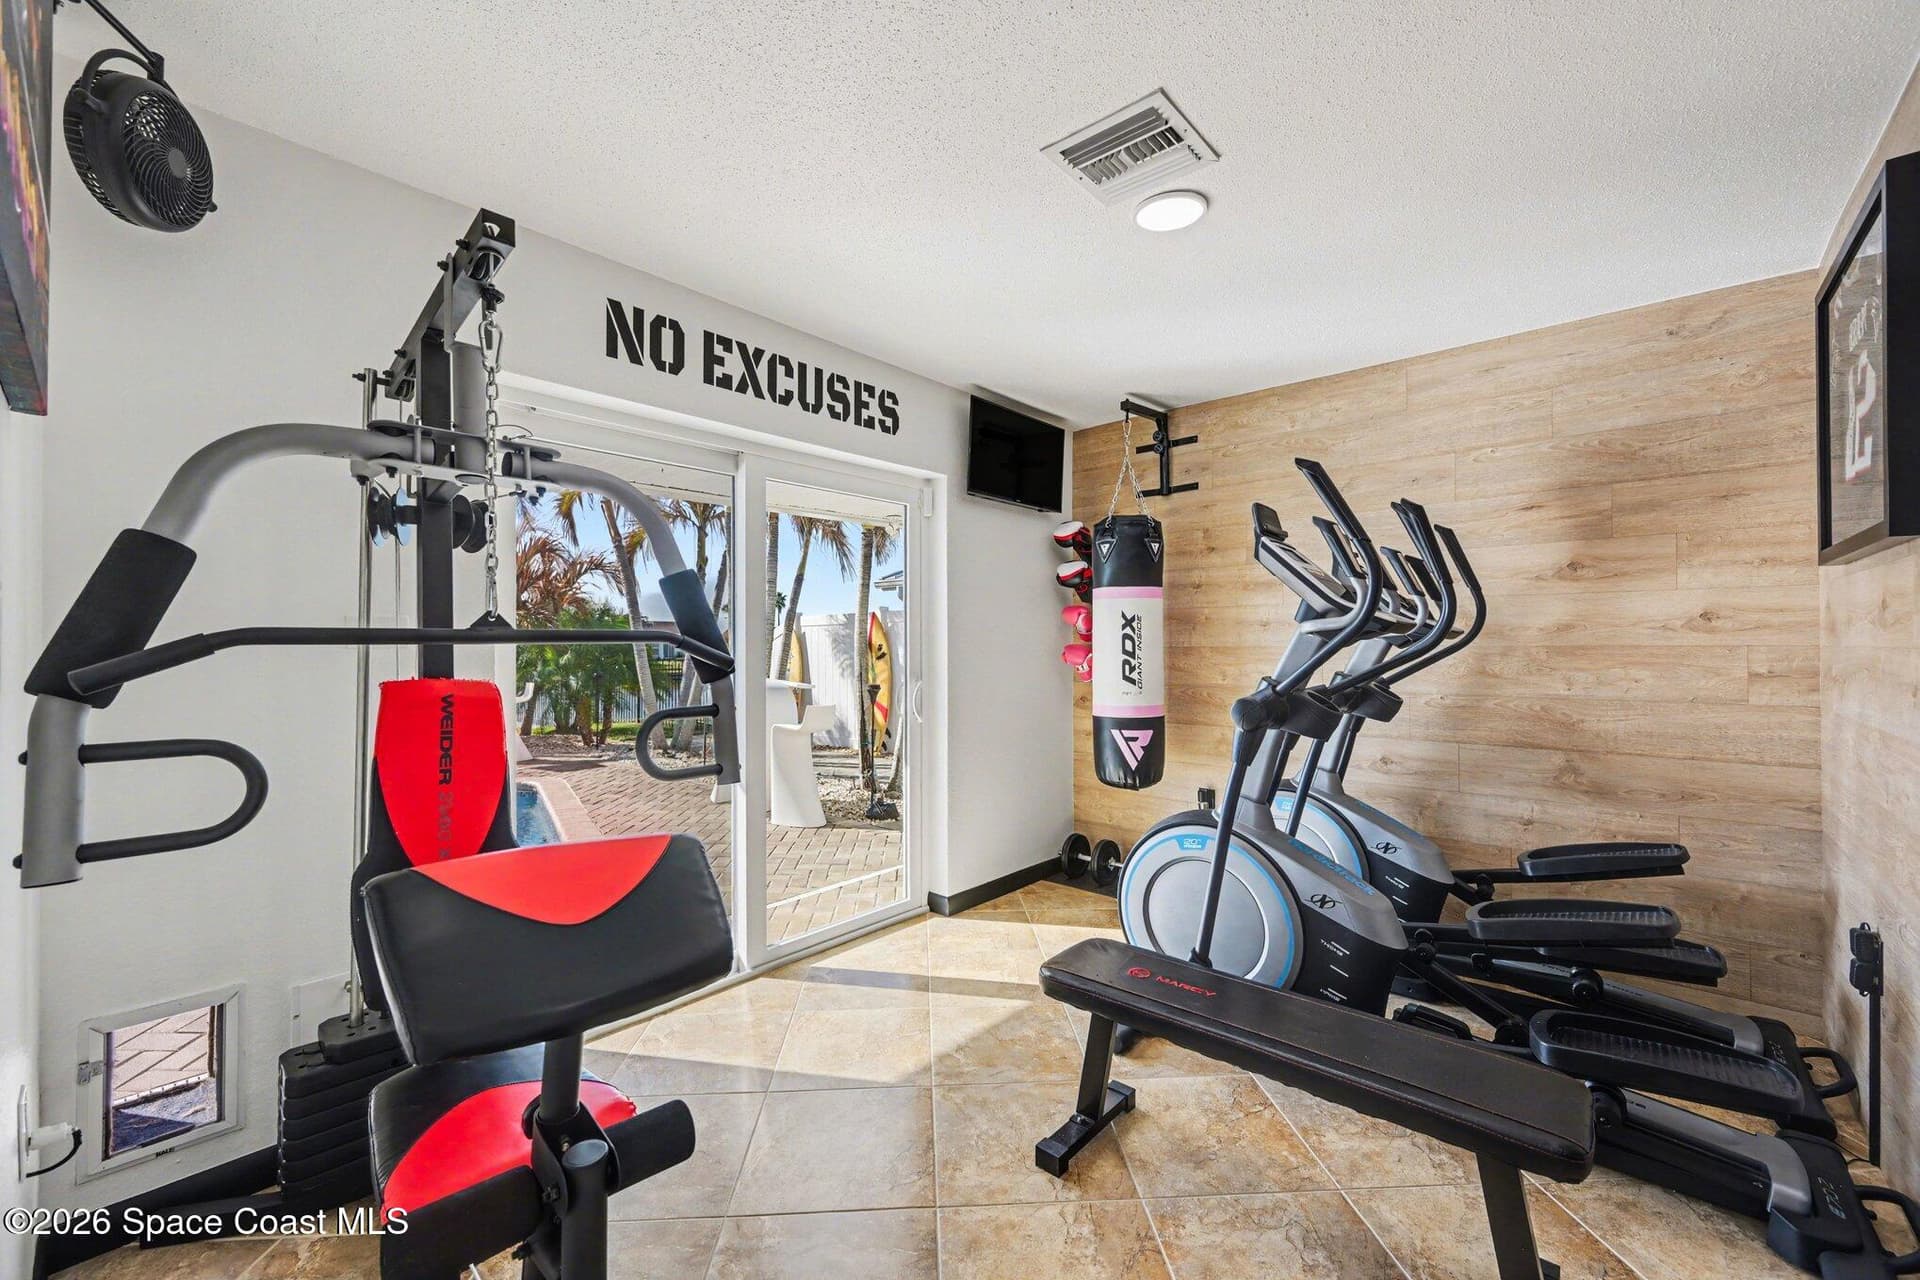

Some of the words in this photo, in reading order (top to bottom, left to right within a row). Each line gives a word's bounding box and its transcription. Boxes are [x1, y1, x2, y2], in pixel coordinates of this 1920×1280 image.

[606, 297, 685, 376] NO
[703, 329, 900, 436] EXCUSES
[1121, 610, 1137, 687] RDX
[439, 693, 455, 785] WEIDER
[1155, 976, 1217, 997] MARCY
